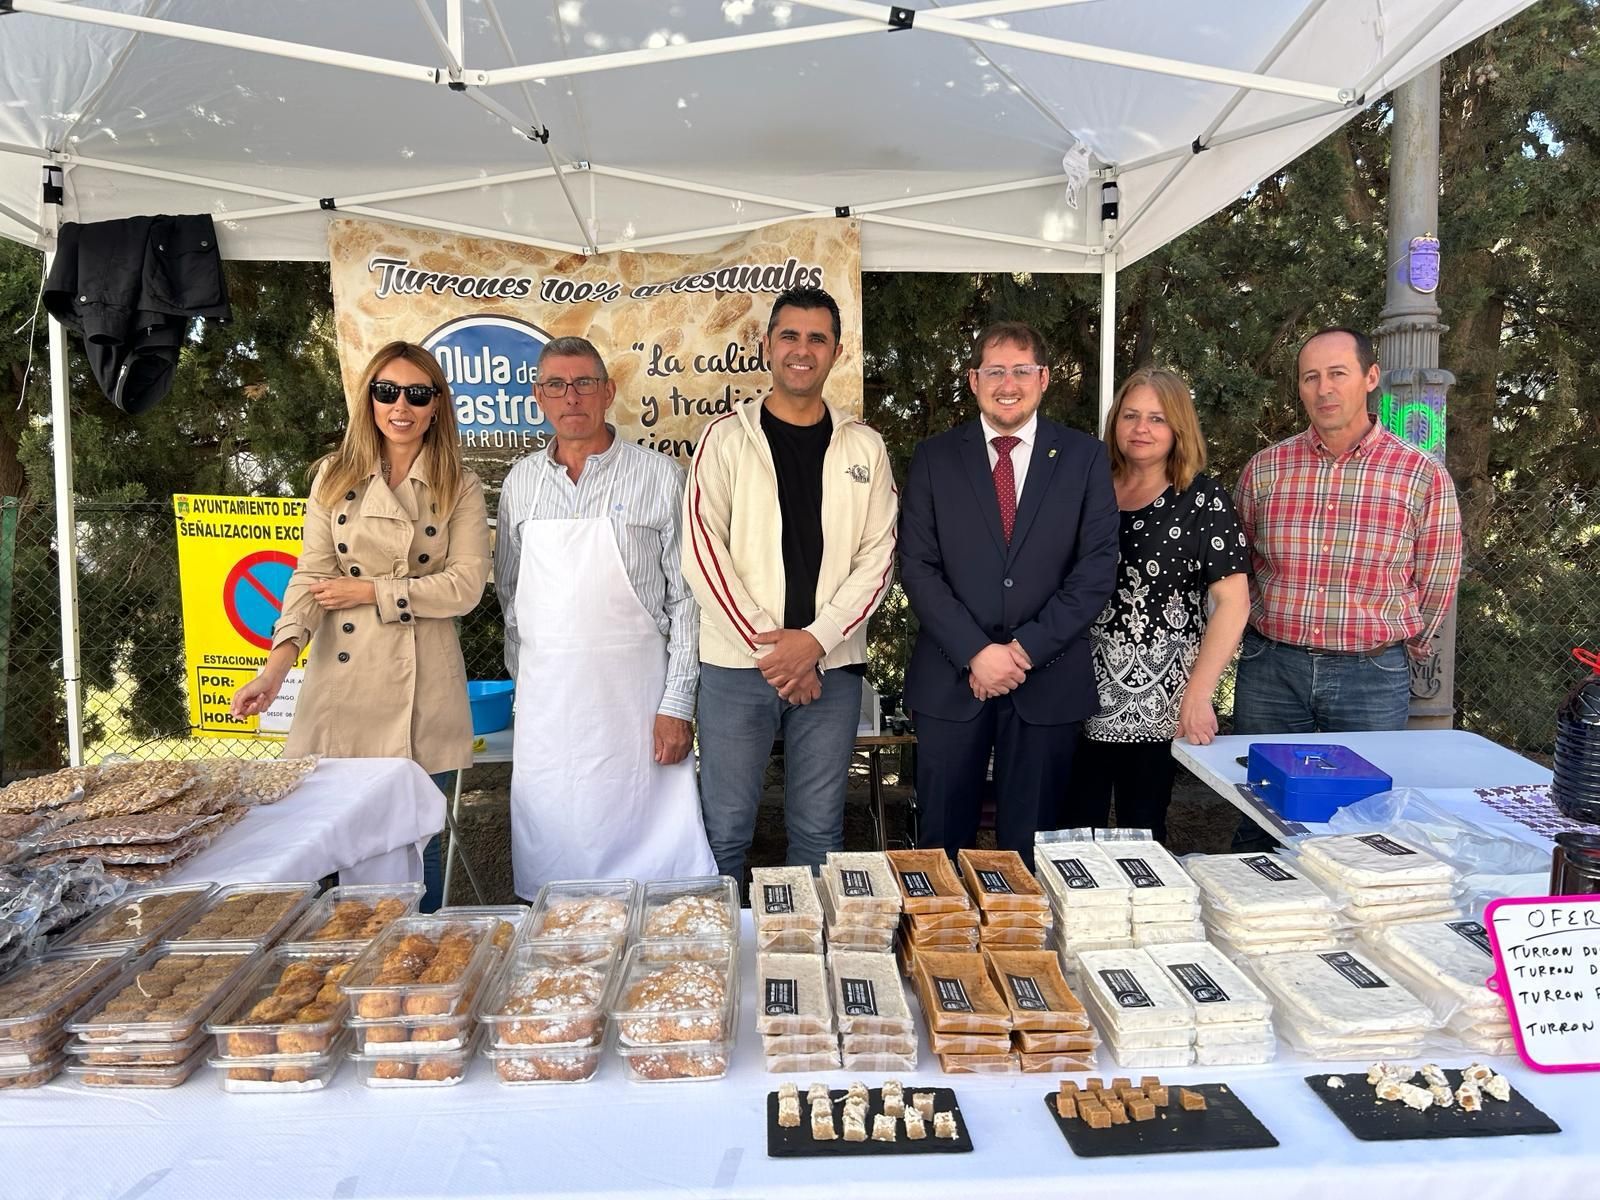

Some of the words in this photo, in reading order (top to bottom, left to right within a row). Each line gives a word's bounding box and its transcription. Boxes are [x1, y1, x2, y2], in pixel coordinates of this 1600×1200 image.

[369, 258, 532, 298] Turrones
[541, 278, 621, 303] 100%
[631, 257, 823, 298] artesanales
[435, 346, 511, 384] Olula
[450, 388, 545, 425] astro
[641, 395, 659, 427] y
[193, 499, 280, 516] AYUNTAMIENTO
[283, 501, 298, 516] DE
[180, 520, 271, 540] SEÑALIZACION
[201, 675, 235, 687] POR:
[202, 691, 231, 706] DÍA:
[1508, 944, 1573, 960] TURRON
[1514, 964, 1574, 978] TURRON
[1518, 988, 1584, 1005] TURRON
[1526, 1020, 1594, 1037] TURRON
